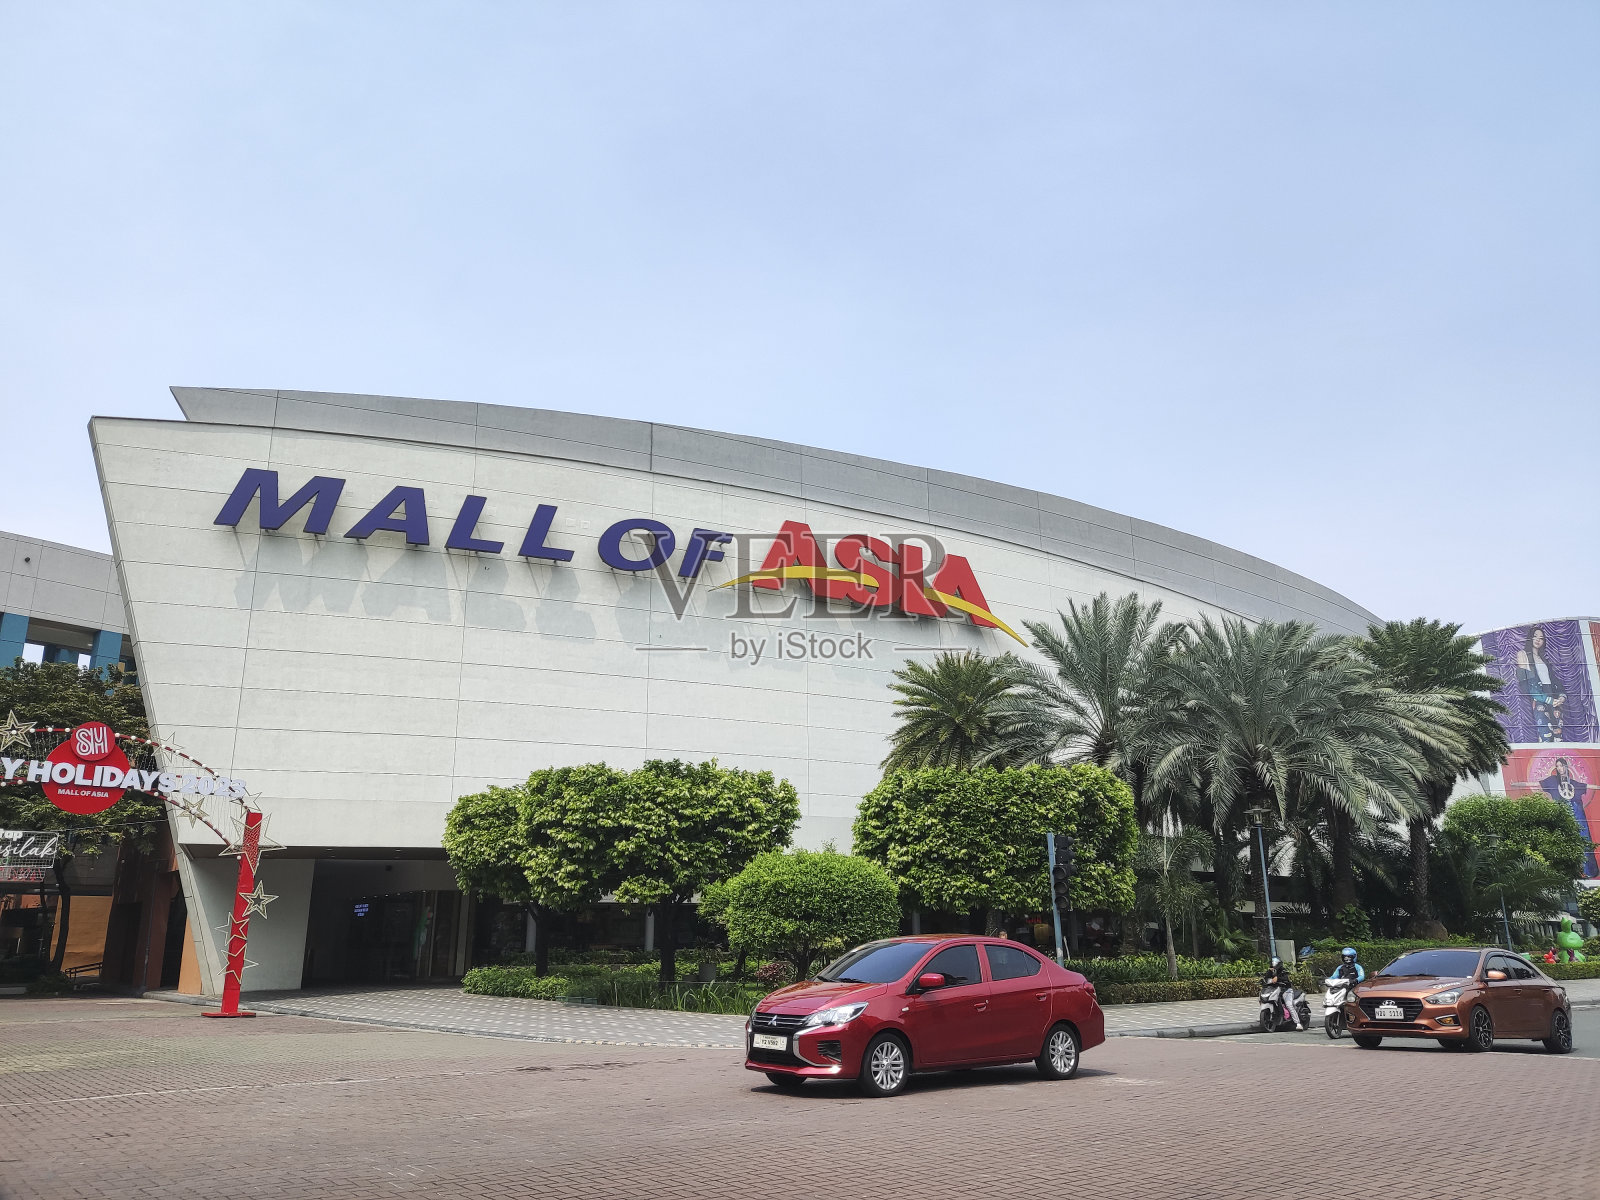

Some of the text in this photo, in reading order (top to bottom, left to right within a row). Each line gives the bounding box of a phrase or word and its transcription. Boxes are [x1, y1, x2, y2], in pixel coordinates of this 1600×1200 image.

[213, 467, 998, 628] MALL OF ASIA
[75, 726, 108, 756] SM
[27, 760, 177, 793] HOLIDAYS
[180, 774, 247, 798] 2023
[58, 788, 81, 797] MALL
[91, 790, 109, 798] ASIA
[0, 836, 57, 858] silak
